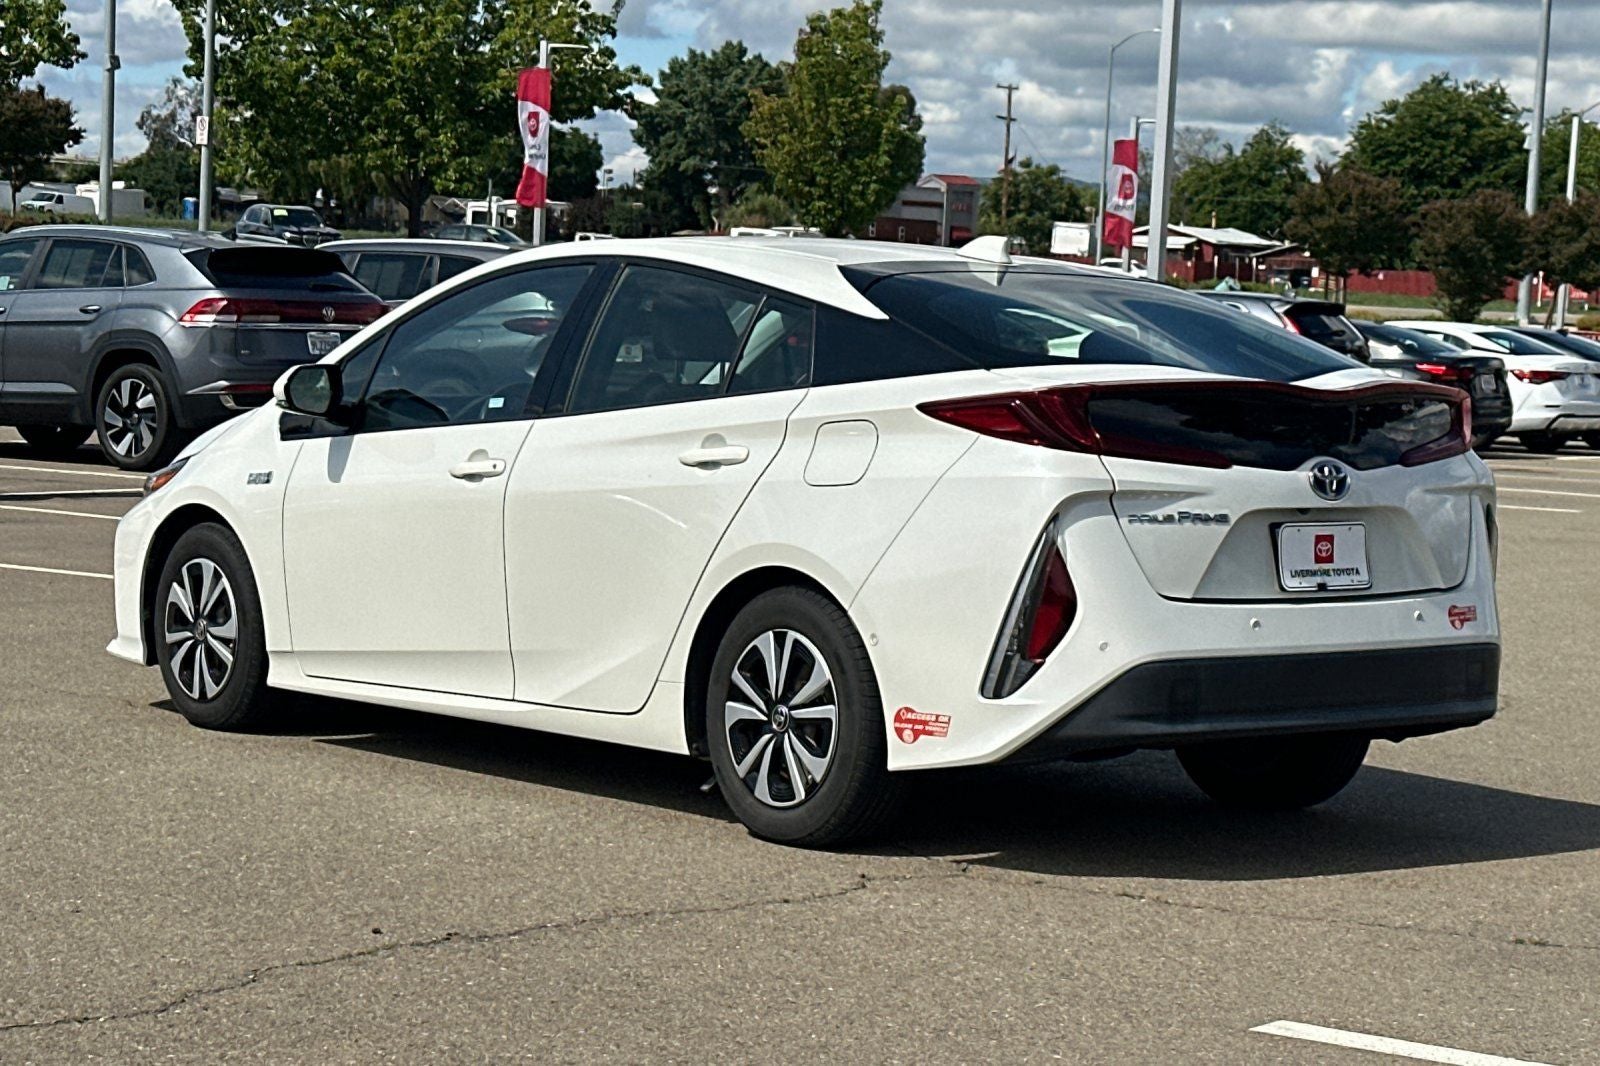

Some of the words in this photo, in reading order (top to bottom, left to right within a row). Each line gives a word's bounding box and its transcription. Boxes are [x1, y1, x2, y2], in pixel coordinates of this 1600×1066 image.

[1290, 569, 1332, 578] LIVERMORE
[1332, 567, 1360, 576] TOYOTA
[906, 712, 936, 721] ACCESS
